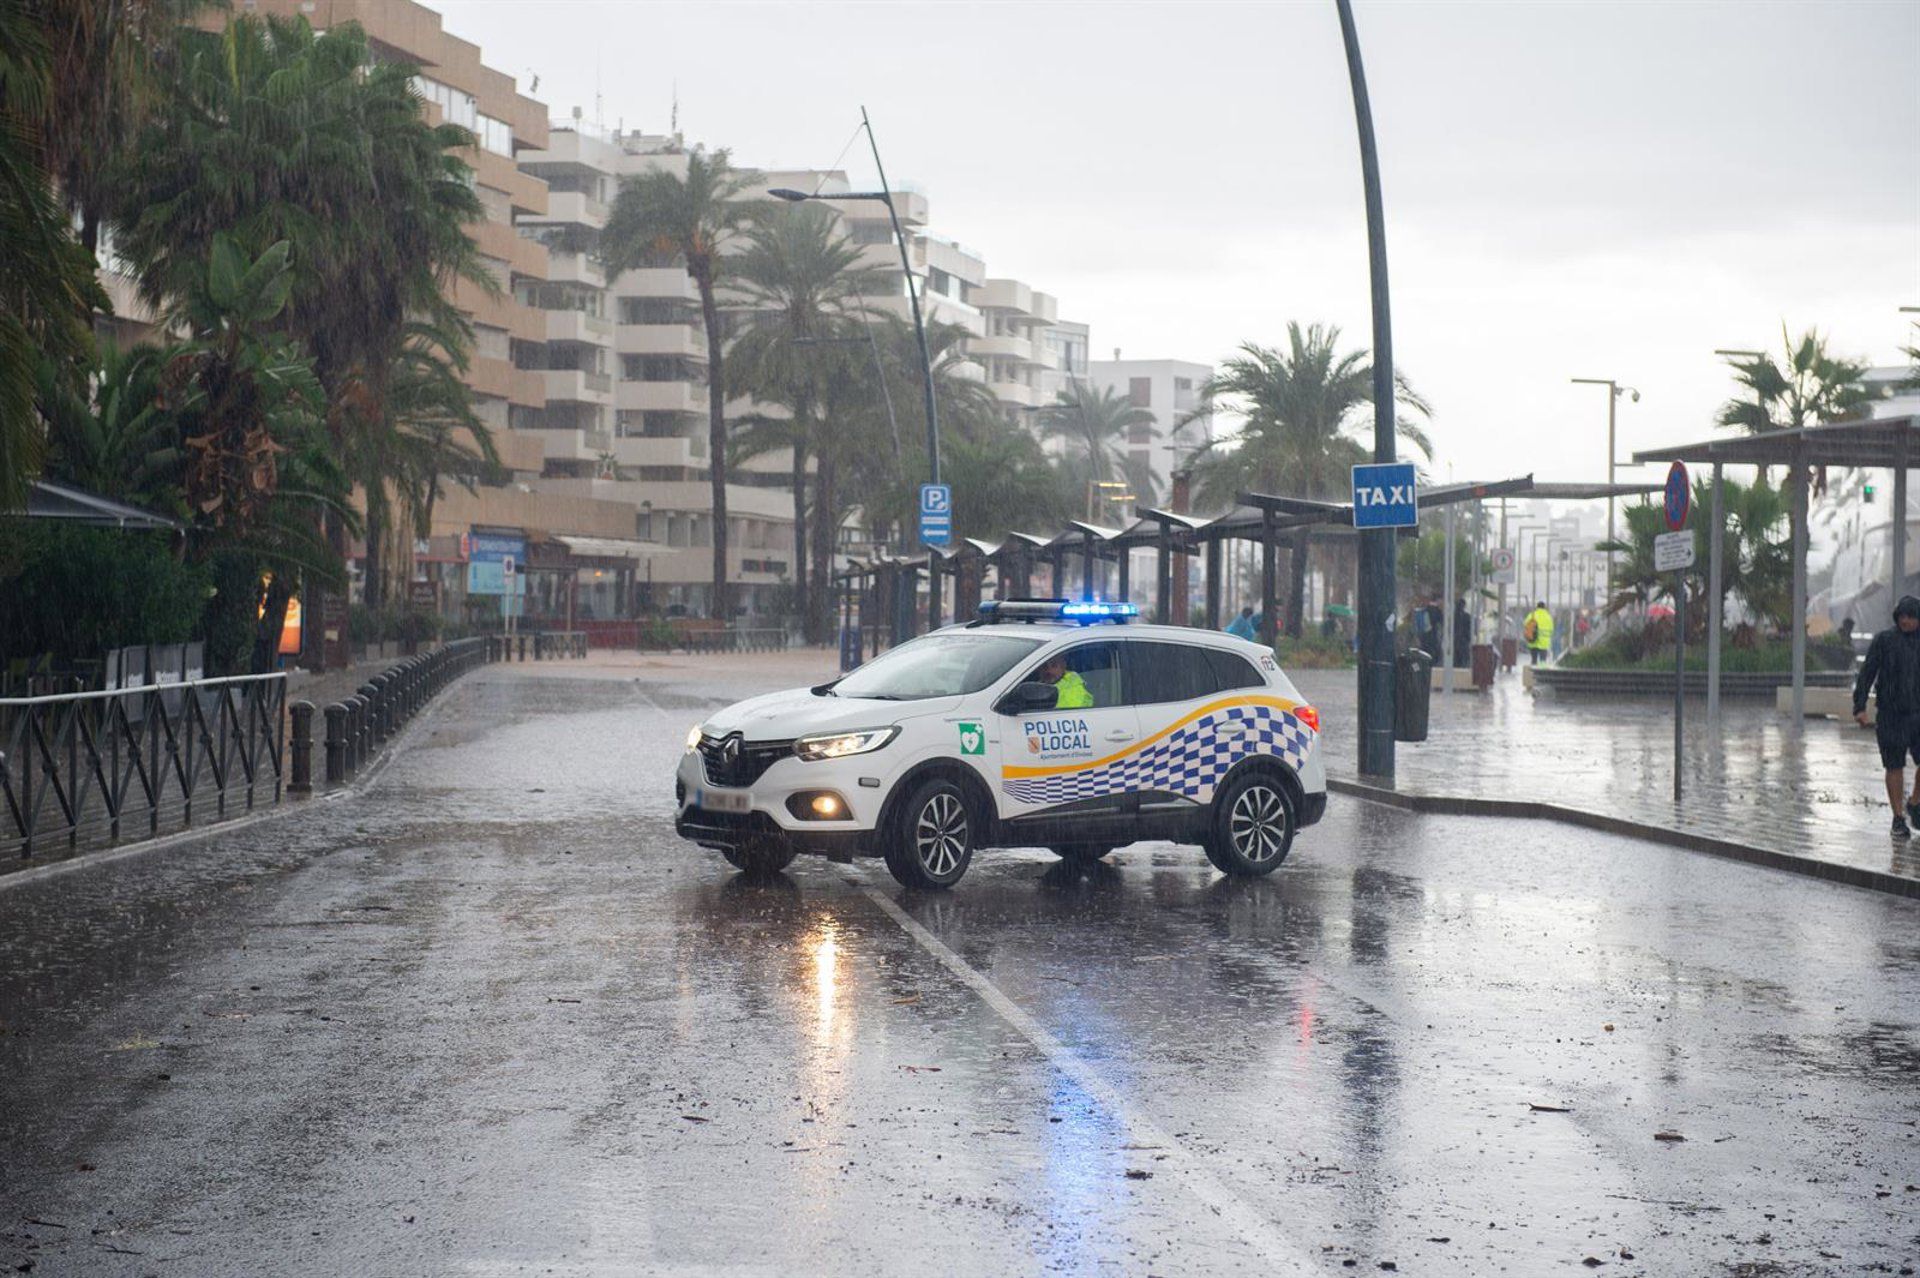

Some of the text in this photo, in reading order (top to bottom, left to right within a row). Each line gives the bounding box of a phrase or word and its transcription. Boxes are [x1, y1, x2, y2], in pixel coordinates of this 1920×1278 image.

[929, 490, 942, 507] P
[1356, 485, 1413, 506] TAXI
[1024, 719, 1088, 736] POLICIA
[1041, 735, 1091, 751] LOCAL
